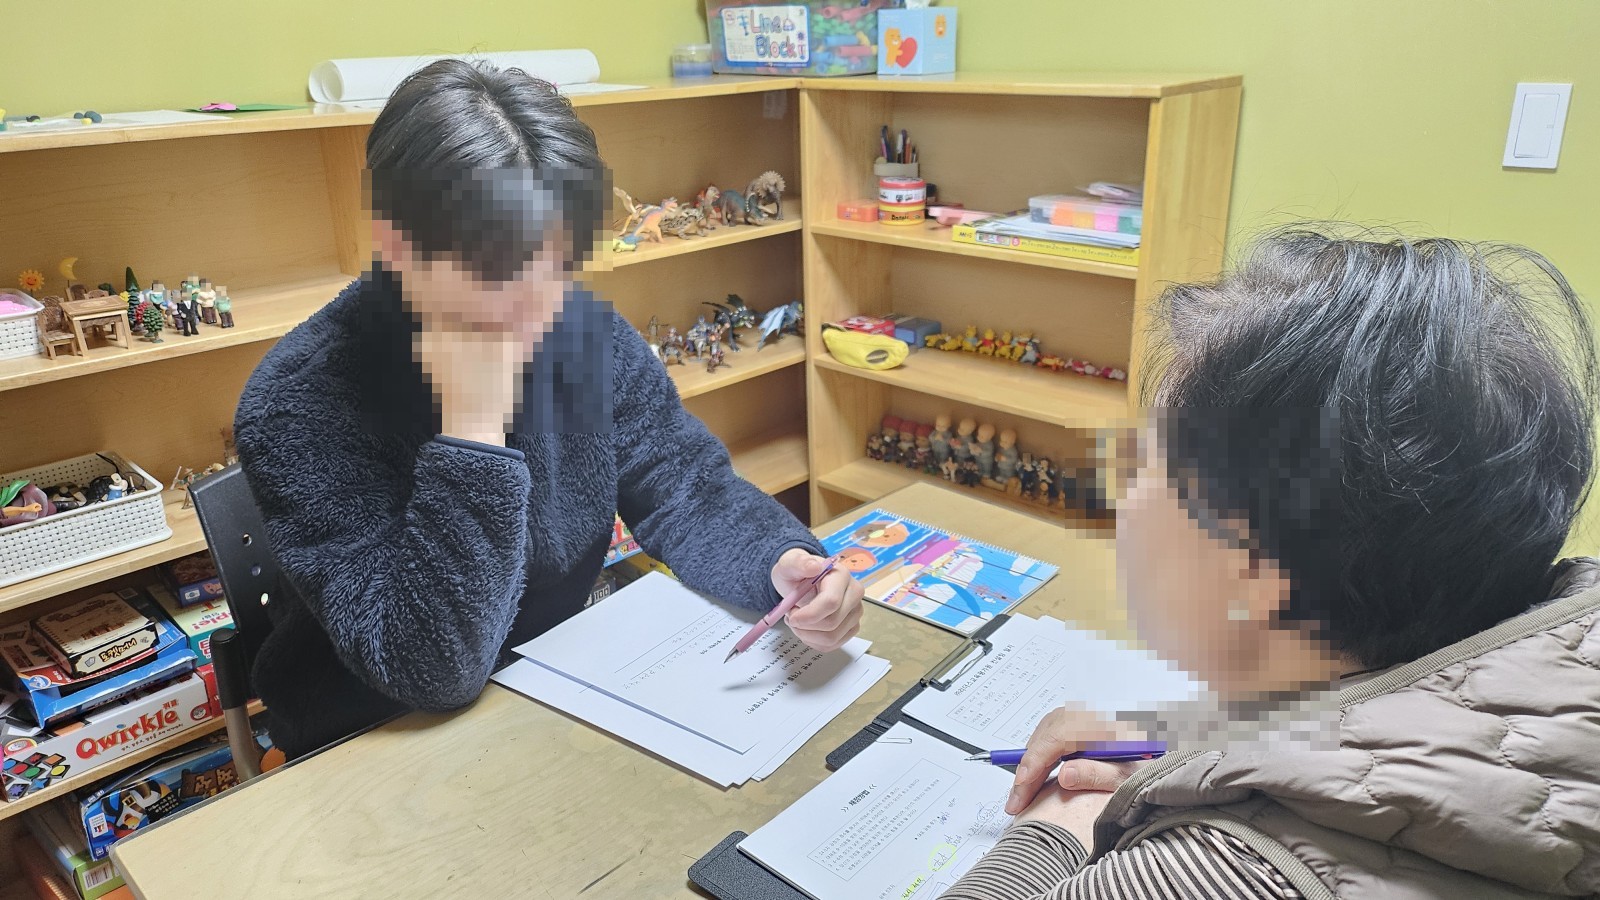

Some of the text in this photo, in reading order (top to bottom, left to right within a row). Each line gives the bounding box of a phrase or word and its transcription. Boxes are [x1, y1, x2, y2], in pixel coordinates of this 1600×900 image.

[755, 34, 797, 59] Block
[768, 681, 788, 697] 중요하게
[76, 708, 180, 760] Qwirkle
